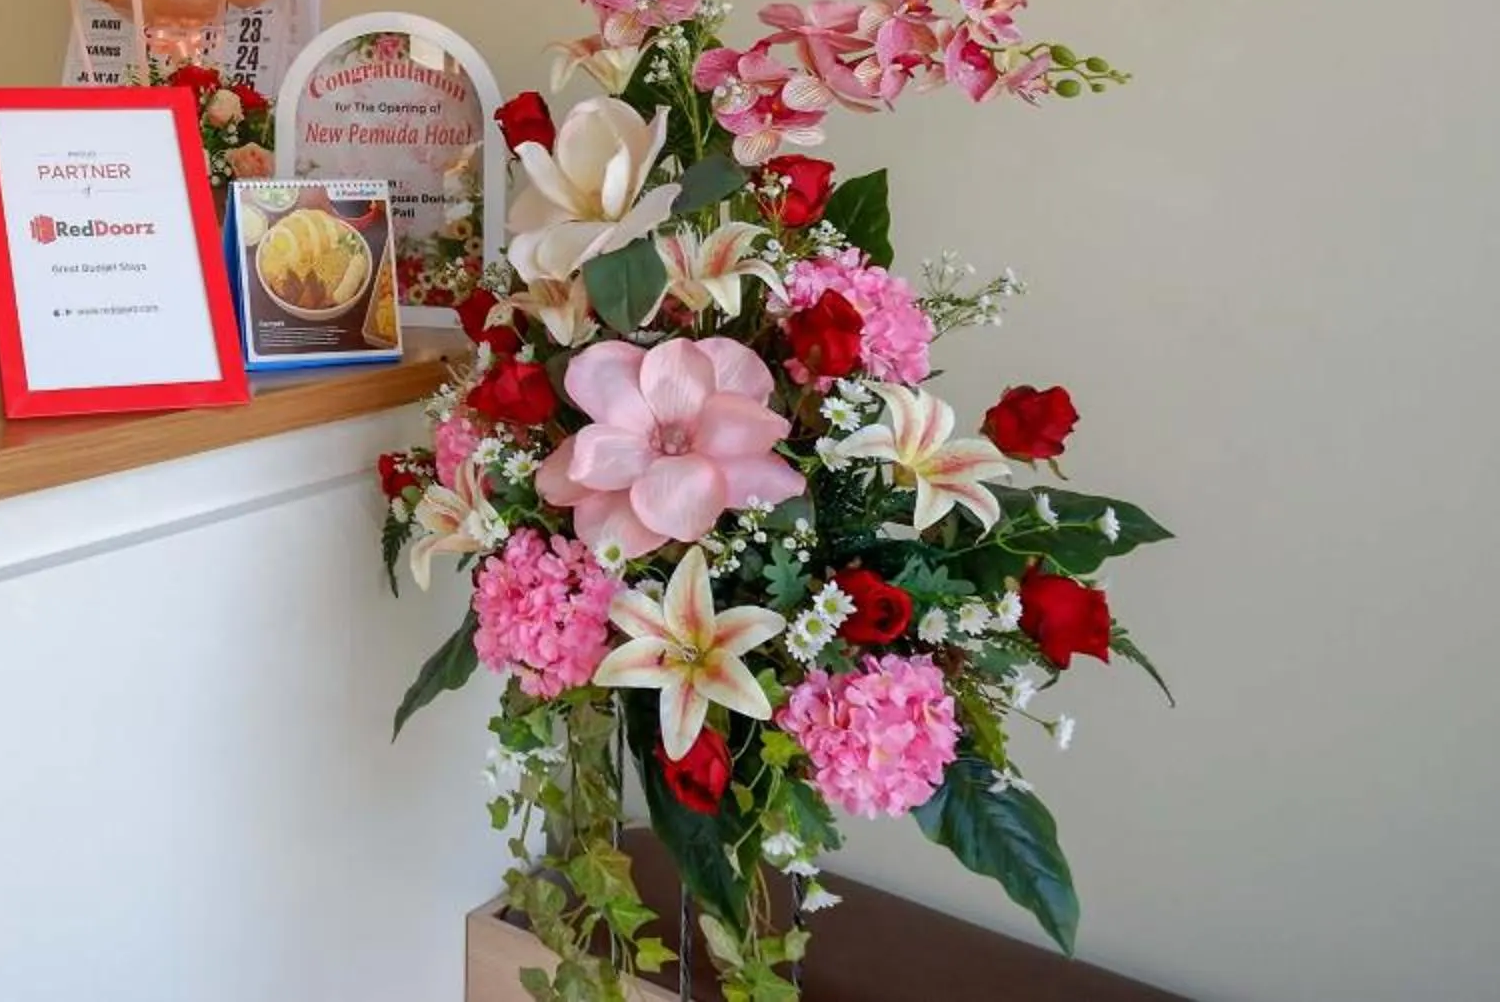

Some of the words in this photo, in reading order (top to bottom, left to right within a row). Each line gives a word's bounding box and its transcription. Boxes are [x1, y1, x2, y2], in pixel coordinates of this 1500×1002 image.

[239, 17, 263, 43] 23
[235, 45, 260, 70] 24
[309, 61, 466, 103] Congratulation
[355, 101, 375, 113] The
[379, 102, 426, 115] Opening
[430, 103, 442, 113] of
[306, 122, 343, 143] New
[350, 123, 418, 145] Pemuda
[425, 122, 472, 145] Hotel
[37, 163, 132, 180] PARTNER
[55, 219, 156, 238] RedDoorz
